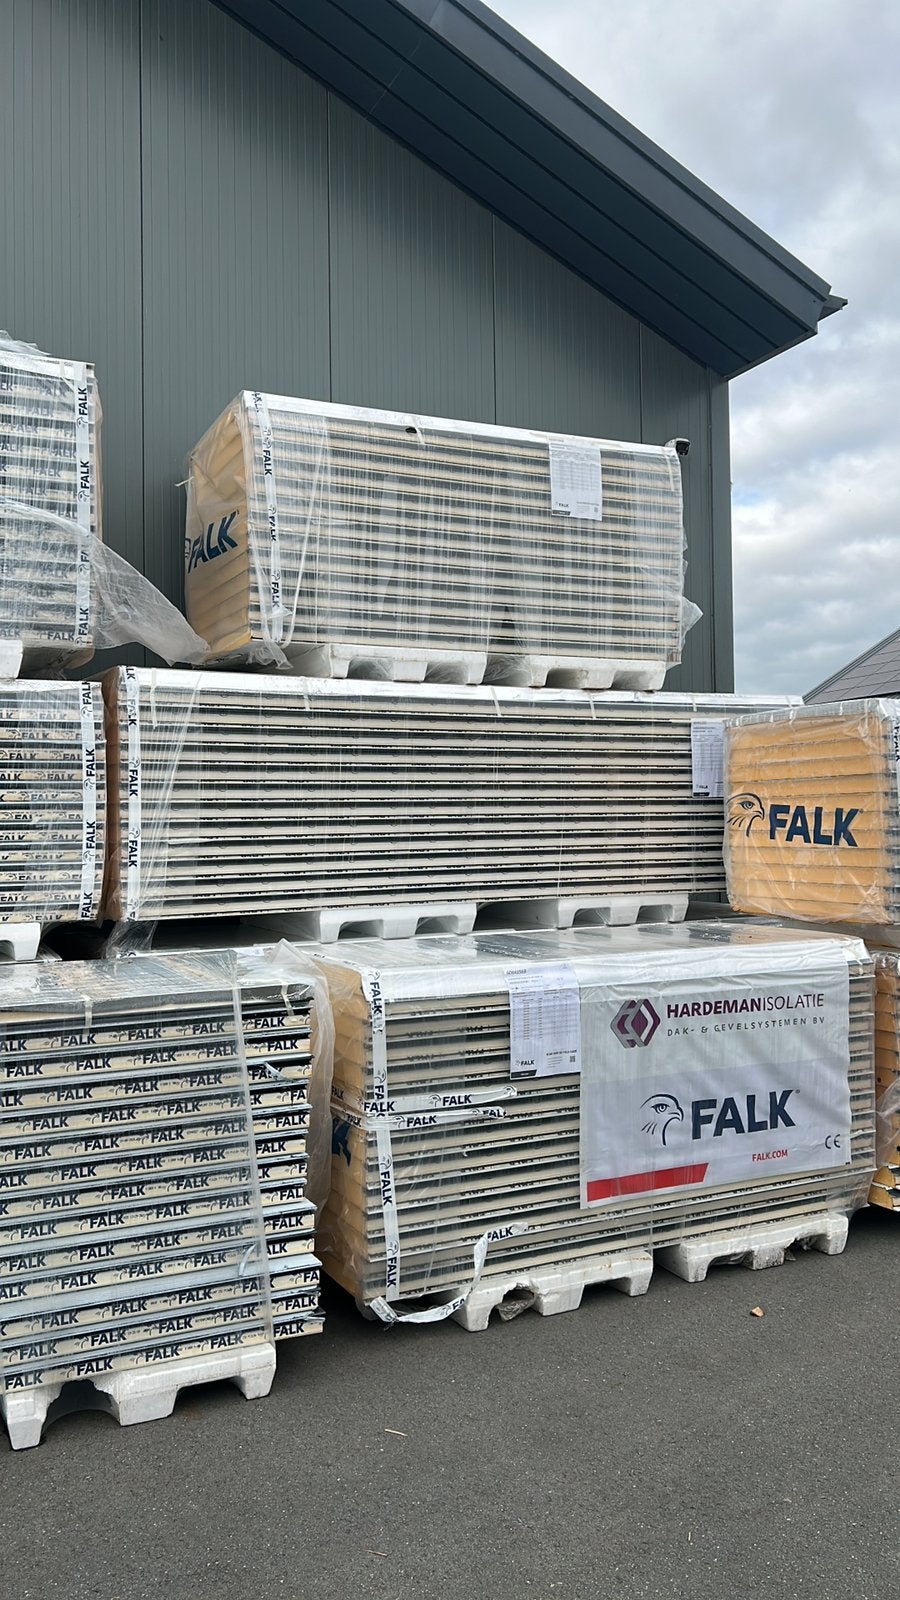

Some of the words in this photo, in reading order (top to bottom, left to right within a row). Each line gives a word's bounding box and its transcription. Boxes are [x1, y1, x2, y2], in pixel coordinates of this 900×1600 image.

[78, 388, 88, 415] FALK
[0, 443, 23, 452] ALK
[80, 461, 90, 489] FALK
[263, 450, 272, 475] FALK
[59, 511, 77, 519] FAL
[188, 511, 238, 574] FALK
[0, 629, 20, 637] ALK
[48, 631, 75, 641] FALK
[79, 607, 89, 635] FALK
[126, 668, 136, 680] LK
[9, 752, 37, 760] FALK
[85, 749, 95, 777] FALK
[0, 773, 21, 781] ALK
[47, 773, 76, 781] FALK
[129, 769, 138, 796] FALK
[86, 821, 96, 849] FALK
[769, 804, 859, 847] FALK
[129, 840, 137, 867] FALK
[81, 892, 93, 918] FALK
[370, 982, 382, 1014] FALK
[667, 993, 825, 1018] HARDEMANISOLATIE
[0, 1039, 27, 1052] ALK
[60, 1033, 96, 1047] FALK
[128, 1028, 162, 1041] FALK
[192, 1022, 225, 1035] FALK
[254, 1017, 285, 1029] FALK
[667, 1027, 694, 1038] DAK-
[701, 1026, 708, 1034] &
[714, 1018, 807, 1033] GEVELSYSTEMEN
[813, 1017, 825, 1025] BV
[6, 1063, 43, 1078] FALK
[76, 1057, 111, 1071] FALK
[142, 1051, 177, 1065] FALK
[206, 1044, 238, 1058] FALK
[267, 1039, 298, 1052] FALK
[0, 1094, 24, 1108] ALK
[56, 1087, 93, 1102] FALK
[124, 1080, 159, 1094] FALK
[189, 1073, 223, 1087] FALK
[364, 1101, 394, 1113] FALK
[443, 1095, 472, 1106] FALK
[32, 1116, 69, 1131] FALK
[101, 1109, 136, 1123] FALK
[166, 1101, 201, 1115] FALK
[290, 1090, 307, 1101] FA
[407, 1115, 436, 1127] FALK
[691, 1090, 796, 1140] FALK
[14, 1145, 51, 1160] FALK
[84, 1137, 120, 1151] FALK
[151, 1129, 184, 1143] FALK
[214, 1122, 246, 1135] FALK
[276, 1114, 306, 1127] FALK
[825, 1134, 841, 1149] CE
[0, 1174, 28, 1188] ALK
[61, 1166, 97, 1180] FALK
[128, 1157, 163, 1171] FALK
[193, 1149, 225, 1163] FALK
[256, 1141, 286, 1155] FALK
[752, 1149, 788, 1162] FALK.COM
[43, 1194, 79, 1209] FALK
[111, 1185, 145, 1199] FALK
[176, 1176, 209, 1190] FALK
[381, 1171, 392, 1206] FALK
[20, 1223, 57, 1239] FALK
[89, 1213, 125, 1229] FALK
[156, 1203, 189, 1218] FALK
[219, 1196, 250, 1209] FALK
[280, 1188, 304, 1201] FAL
[9, 1256, 46, 1271] FALK
[79, 1244, 115, 1260] FALK
[147, 1234, 180, 1249] FALK
[211, 1225, 243, 1239] FALK
[272, 1216, 303, 1230] FALK
[0, 1284, 27, 1299] ALK
[61, 1273, 97, 1289] FALK
[129, 1262, 163, 1278] FALK
[194, 1252, 226, 1267] FALK
[387, 1256, 398, 1287] FALK
[41, 1312, 79, 1329] FALK
[111, 1300, 147, 1316] FALK
[179, 1289, 212, 1304] FALK
[303, 1272, 319, 1283] FA
[452, 1298, 465, 1310] FA
[19, 1344, 58, 1360] FALK
[90, 1330, 126, 1346] FALK
[158, 1319, 193, 1334] FALK
[223, 1306, 256, 1322] FALK
[285, 1296, 316, 1310] FALK
[5, 1371, 43, 1390] FALK
[76, 1359, 113, 1376] FALK
[145, 1346, 180, 1362] FALK
[210, 1333, 243, 1349] FALK
[274, 1322, 304, 1337] FALK
